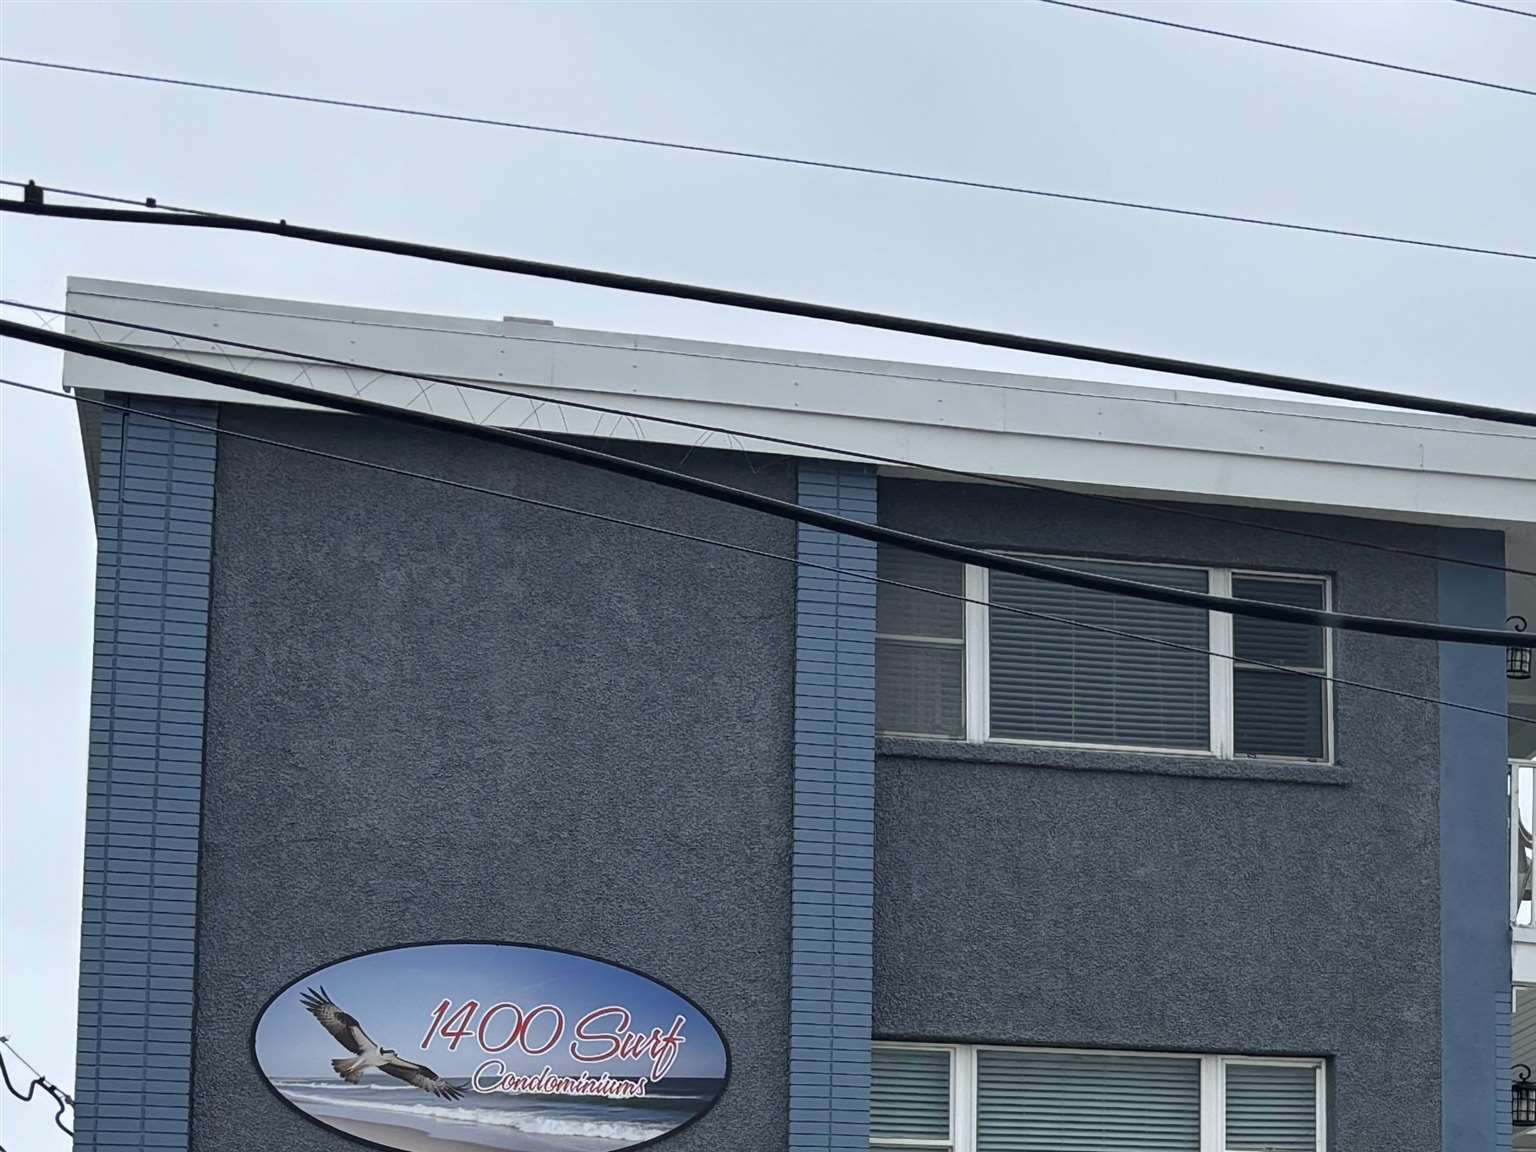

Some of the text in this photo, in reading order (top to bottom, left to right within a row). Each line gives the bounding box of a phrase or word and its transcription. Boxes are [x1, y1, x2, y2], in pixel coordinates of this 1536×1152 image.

[420, 999, 686, 1083] 1400 Surf
[472, 1059, 648, 1097] Condominiums
